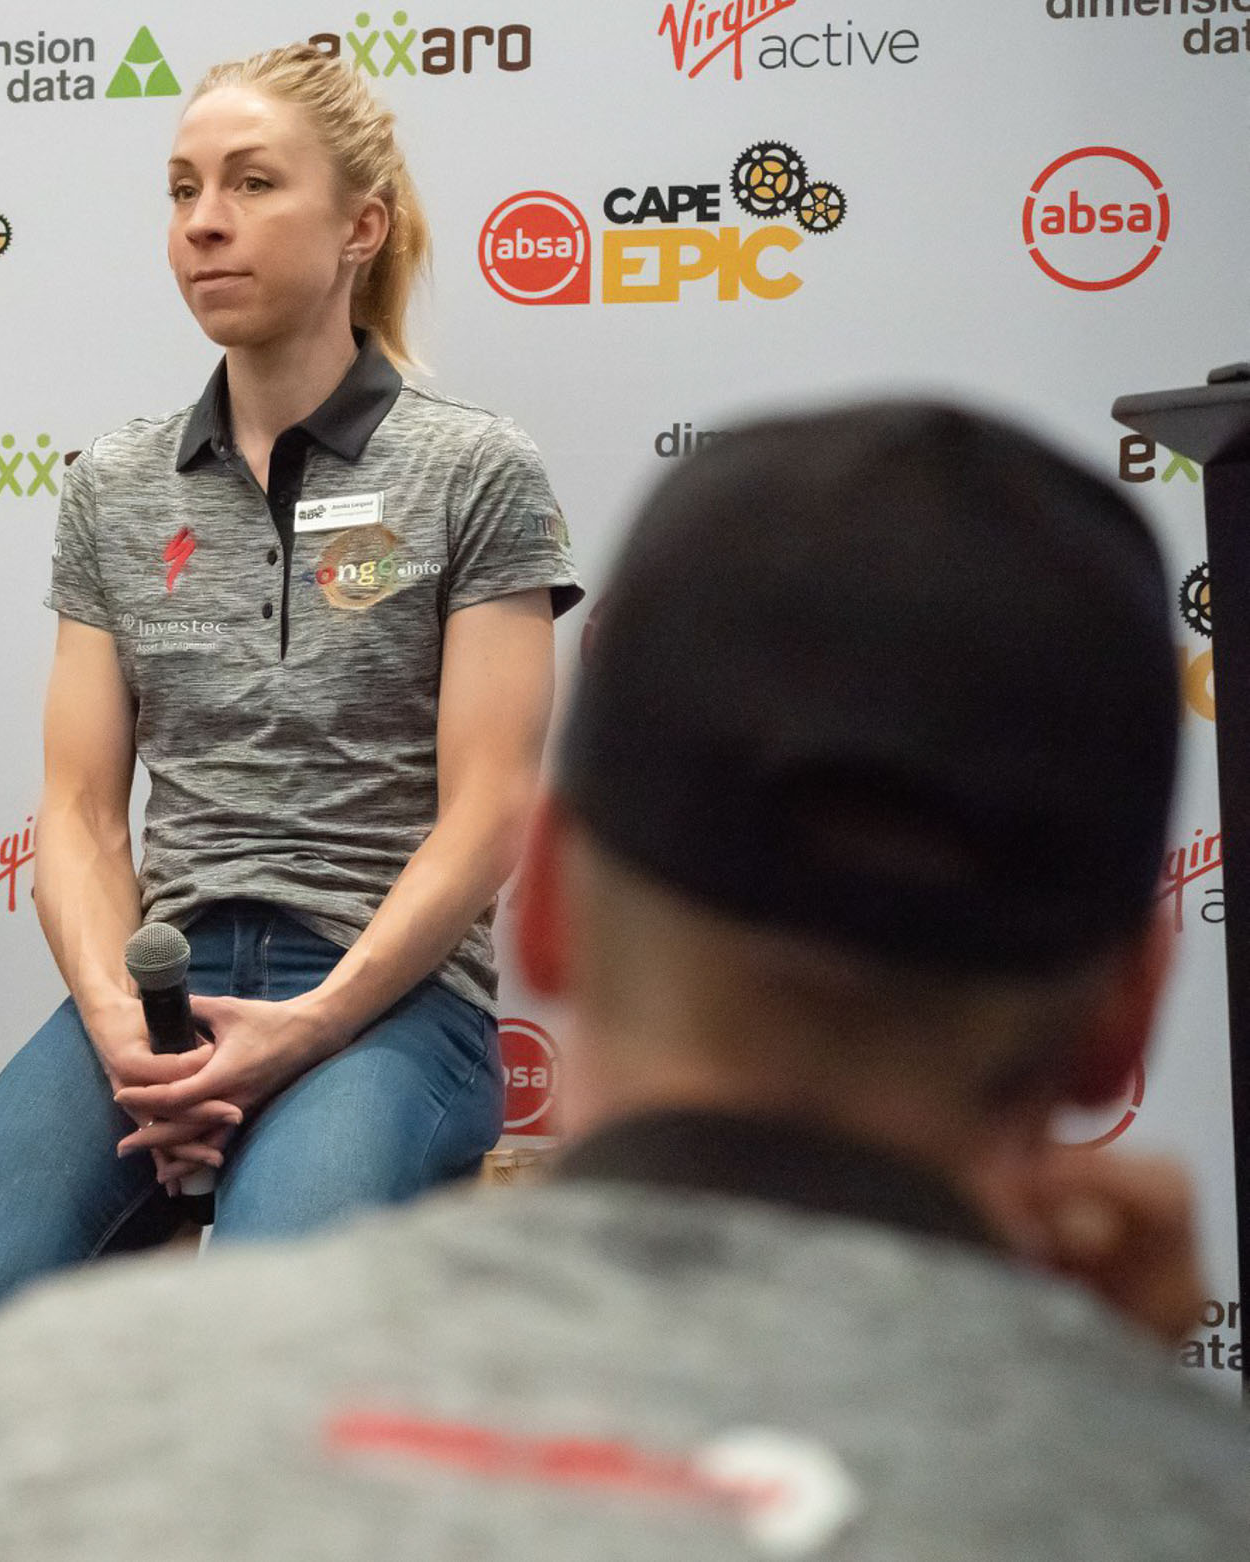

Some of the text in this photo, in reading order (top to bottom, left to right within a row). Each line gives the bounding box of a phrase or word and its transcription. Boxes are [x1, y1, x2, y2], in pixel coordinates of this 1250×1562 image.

[758, 20, 919, 69] active
[7, 69, 94, 103] data
[603, 185, 721, 224] CAPE
[1041, 190, 1152, 235] absa
[496, 227, 572, 260] absa
[602, 225, 803, 304] EPIC
[138, 619, 228, 636] Investec
